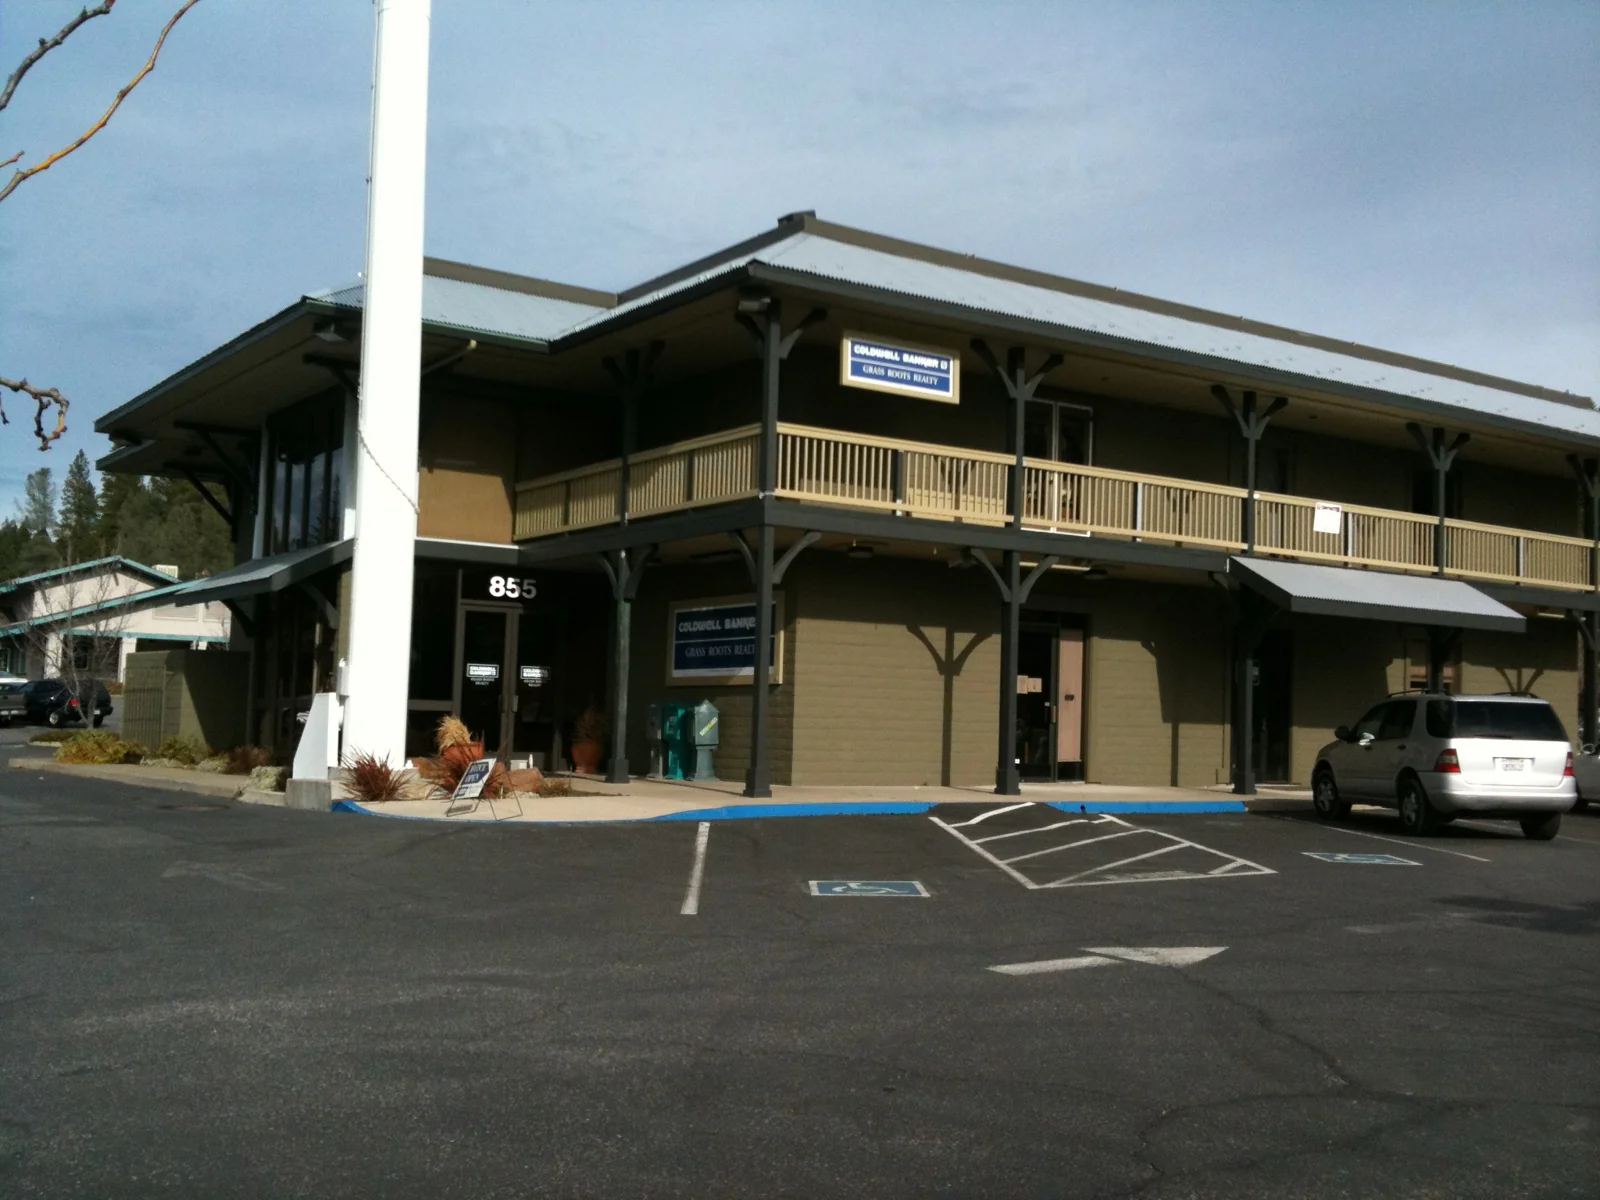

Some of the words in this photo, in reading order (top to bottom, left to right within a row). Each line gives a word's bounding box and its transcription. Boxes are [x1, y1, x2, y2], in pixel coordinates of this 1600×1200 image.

[853, 344, 900, 361] COLDWELL
[902, 353, 939, 368] BANKER
[862, 365, 885, 376] GRASS
[887, 368, 911, 381] ROOTS
[913, 374, 939, 386] REALTY
[489, 575, 537, 599] 855
[678, 620, 722, 632] COLDWELL
[724, 616, 756, 630] BANKE
[684, 646, 706, 658] GRASS
[708, 645, 732, 657] ROOTS
[734, 644, 756, 655] REALT
